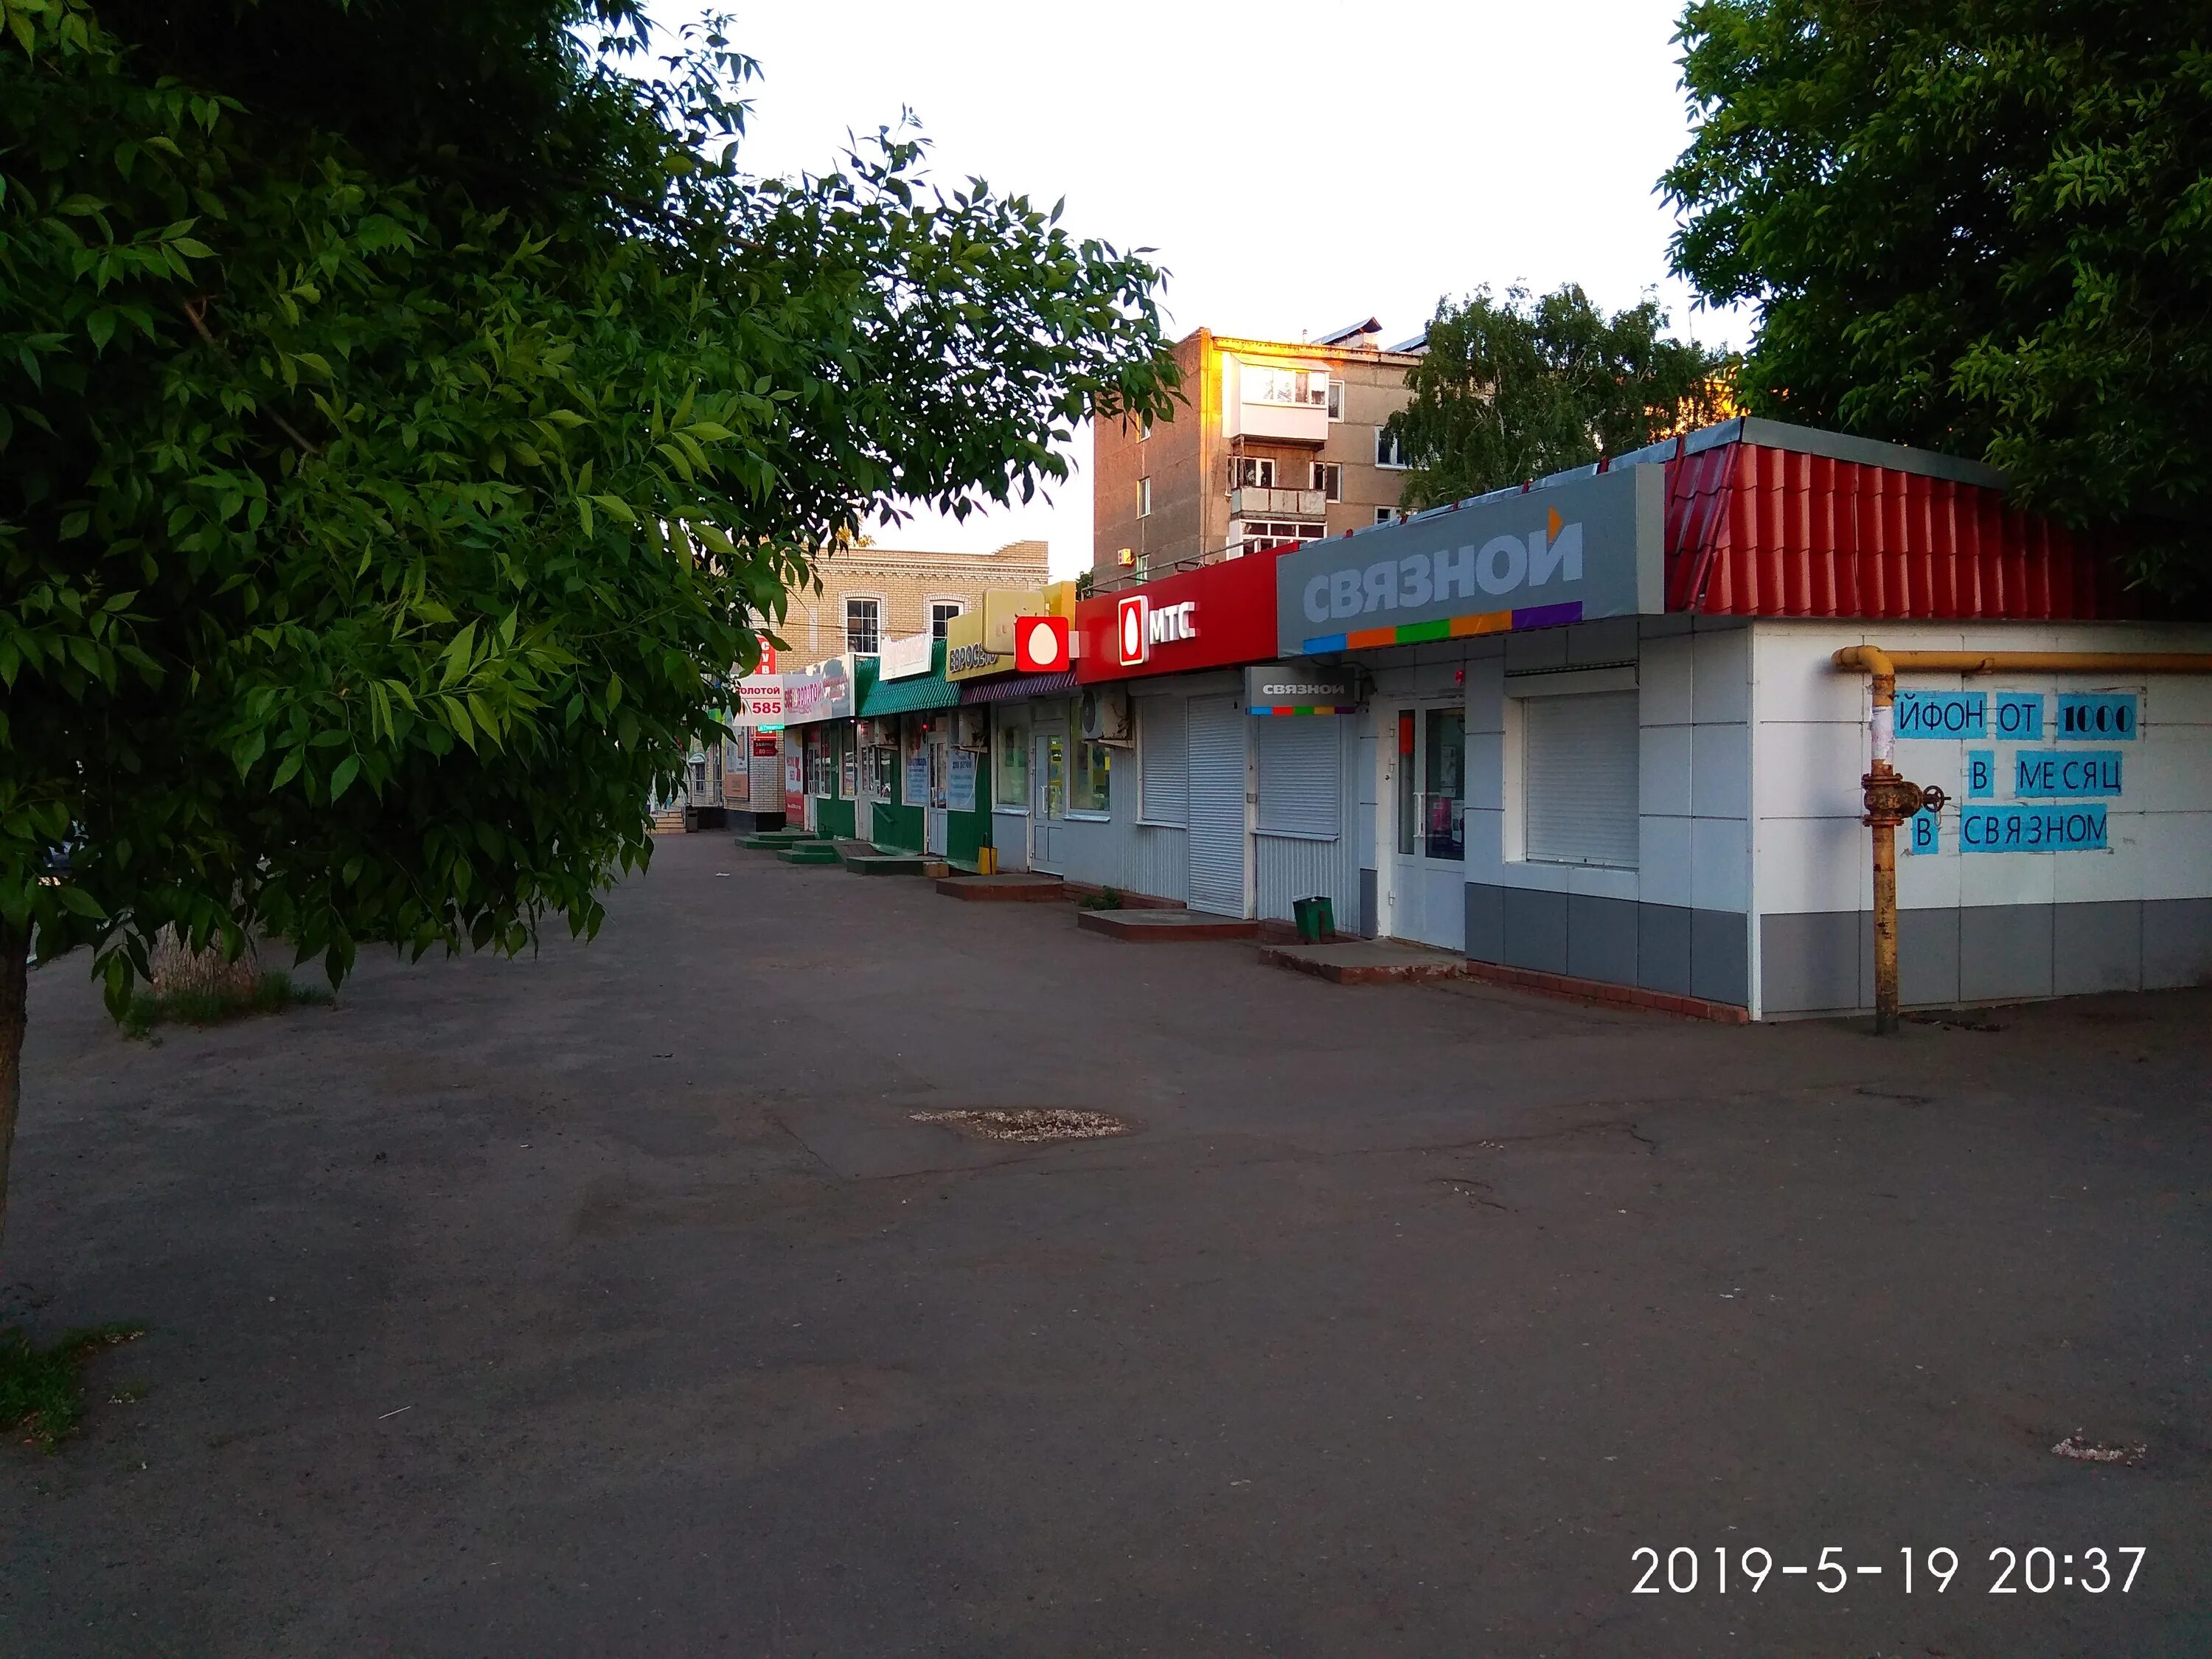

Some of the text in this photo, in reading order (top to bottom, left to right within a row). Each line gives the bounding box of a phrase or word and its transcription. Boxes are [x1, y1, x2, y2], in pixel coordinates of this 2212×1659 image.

[1304, 507, 1583, 623] СВЯЗНОЙ
[1150, 602, 1196, 645] МТС
[752, 702, 782, 714] 585
[2000, 703, 2037, 731] ОТ
[2063, 705, 2134, 732] 1000
[1973, 761, 2121, 793] В МЕСЯЦ
[1917, 814, 2107, 846] В СВЯЗНОМ
